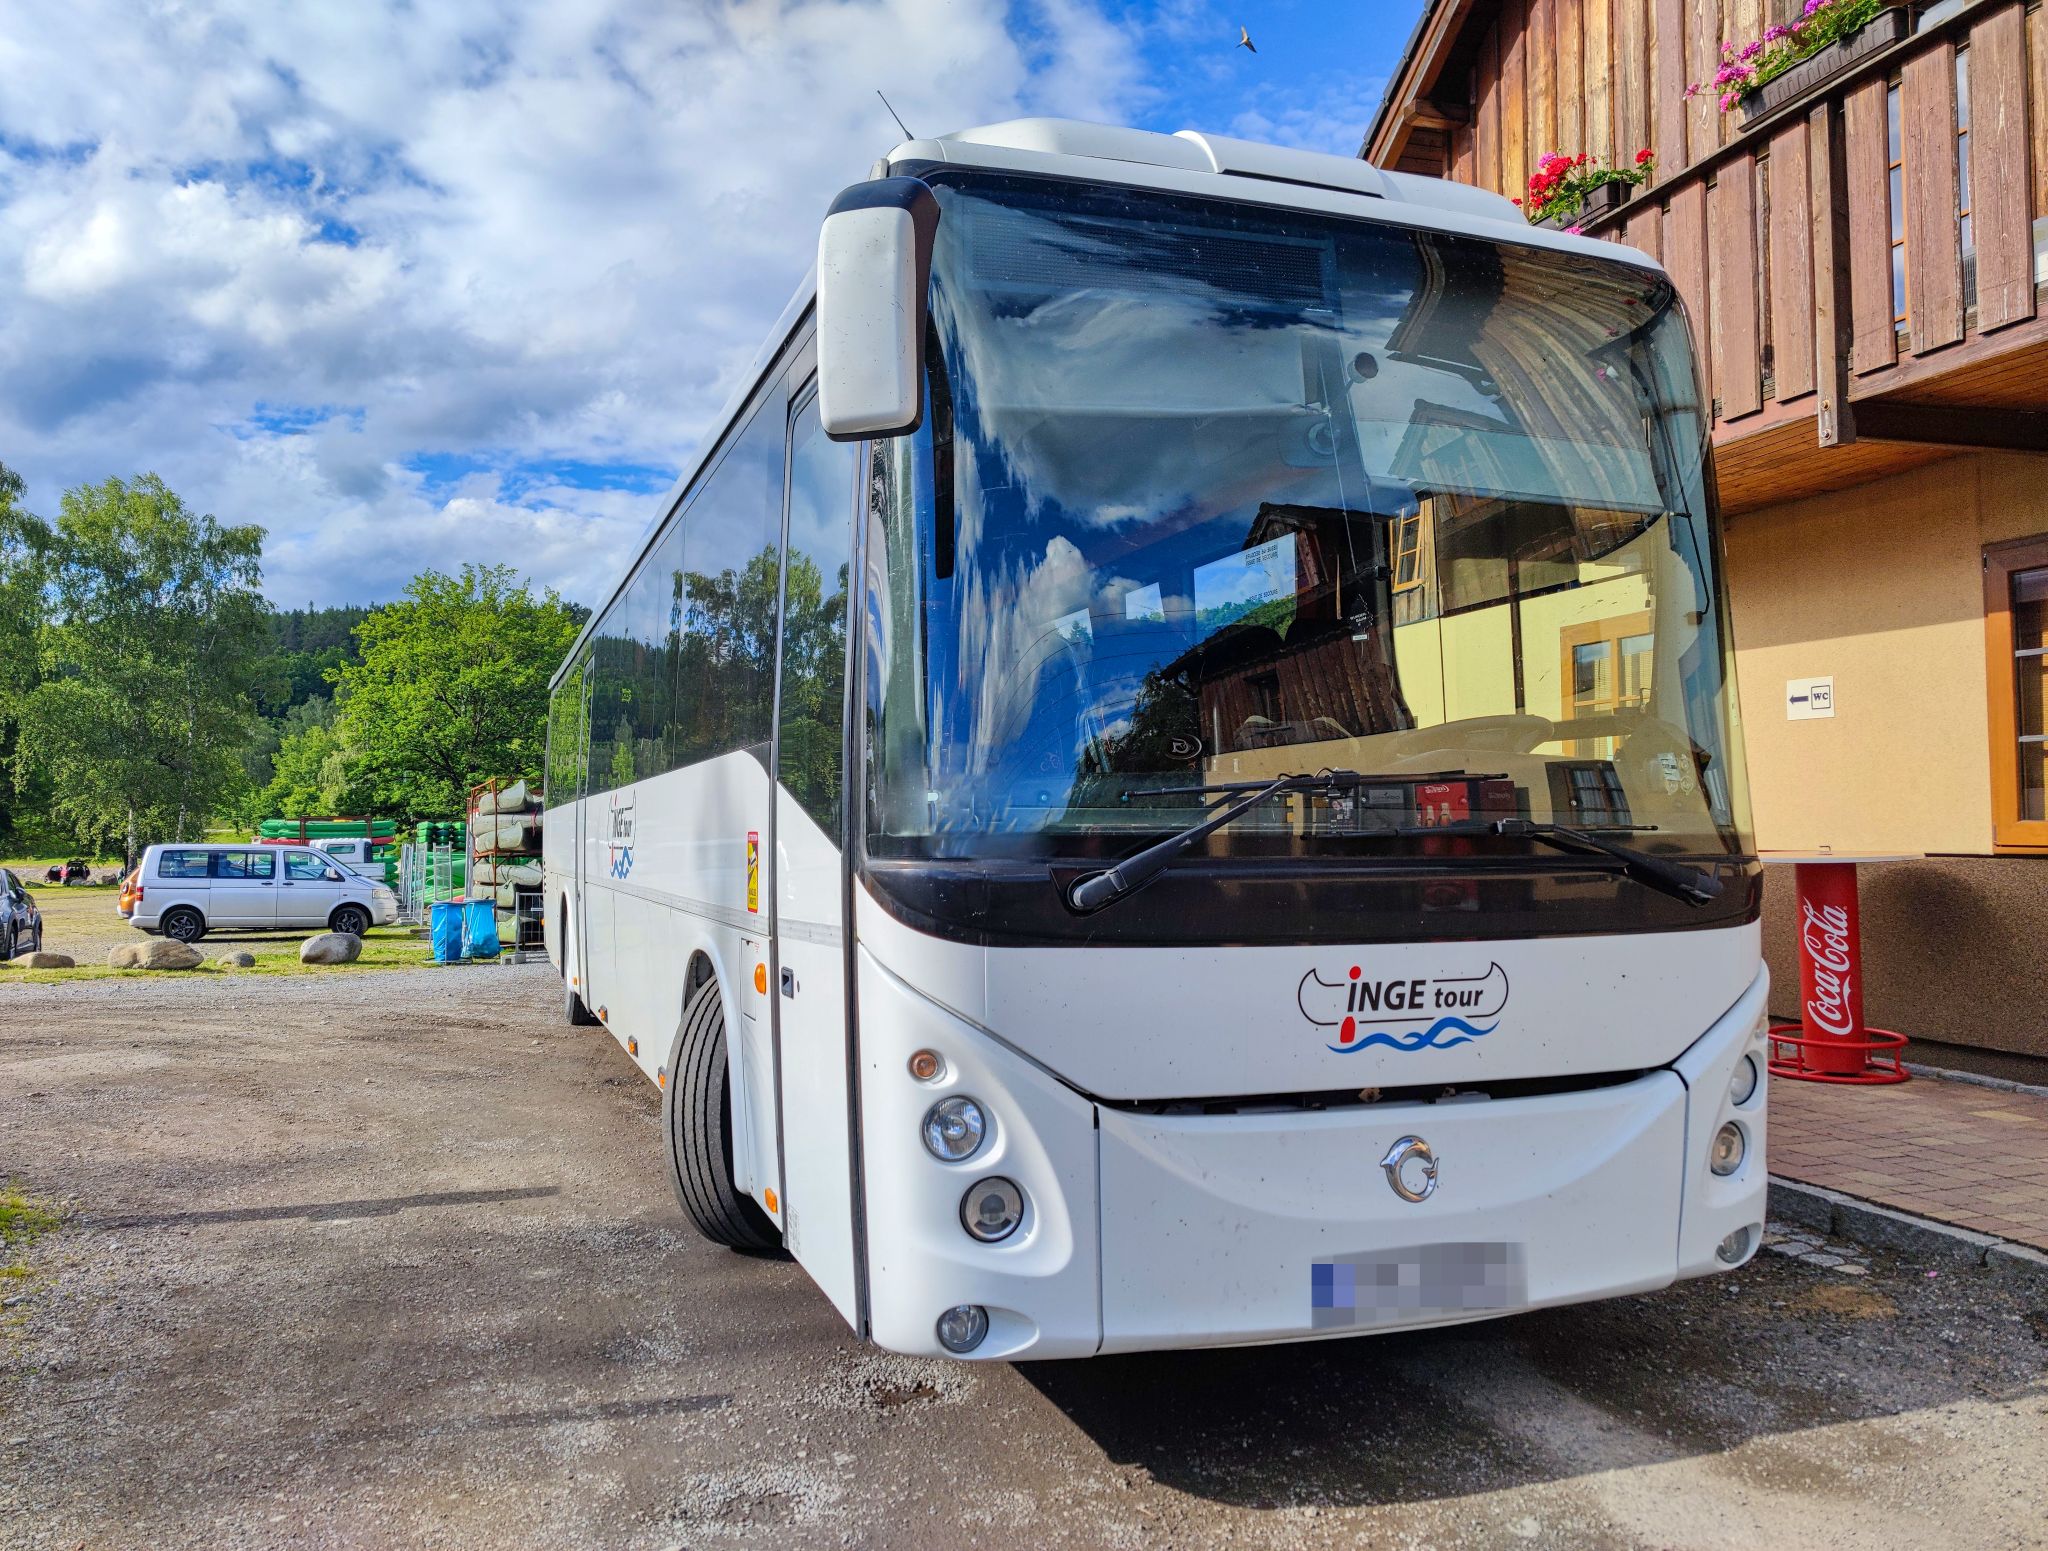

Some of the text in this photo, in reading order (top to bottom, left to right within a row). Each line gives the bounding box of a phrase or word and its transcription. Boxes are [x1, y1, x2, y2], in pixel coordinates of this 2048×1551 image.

[1813, 692, 1829, 701] WC
[1803, 896, 1853, 1035] Coca-Cola
[1434, 988, 1484, 1008] tour
